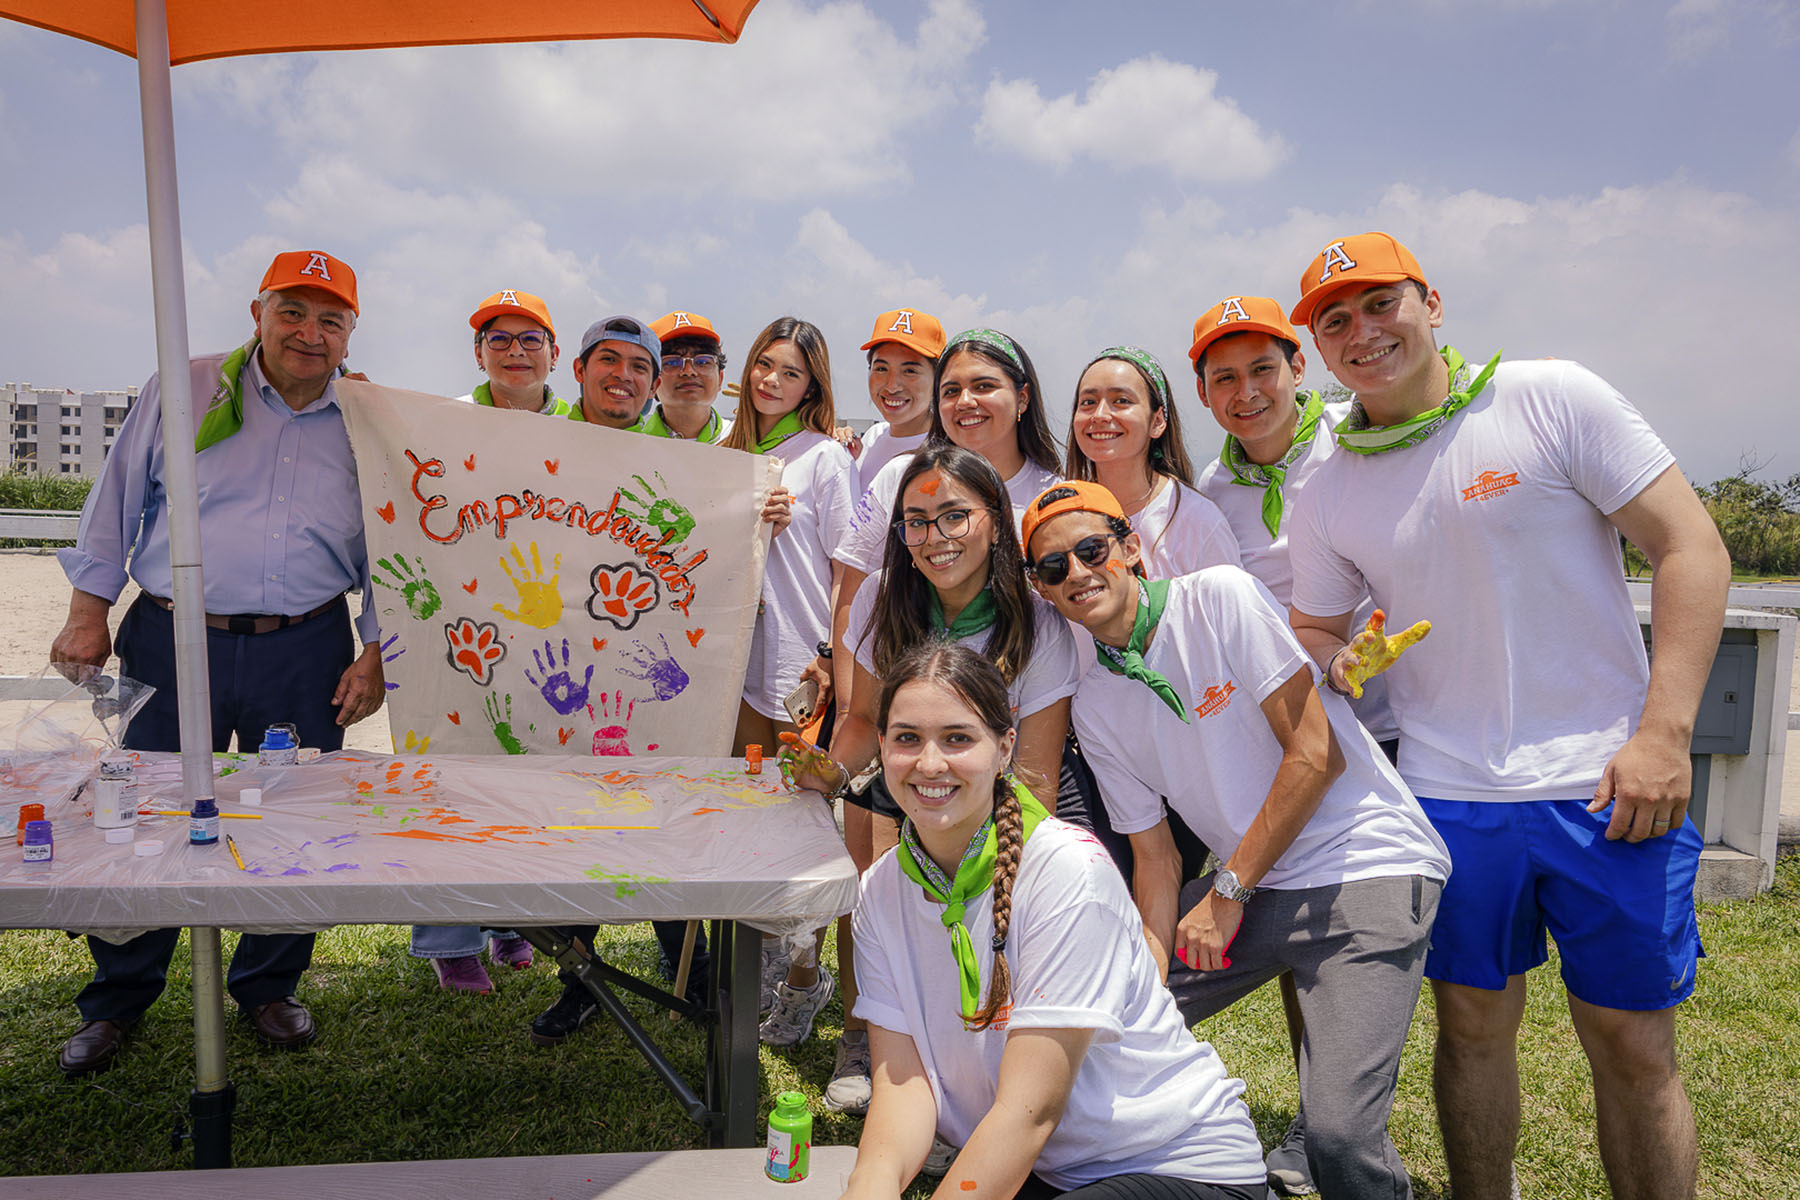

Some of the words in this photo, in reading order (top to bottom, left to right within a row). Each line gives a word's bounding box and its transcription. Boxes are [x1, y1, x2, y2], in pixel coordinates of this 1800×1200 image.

[300, 252, 331, 281] A
[1319, 241, 1357, 285] A
[499, 290, 521, 307] A
[673, 312, 693, 330] A
[887, 310, 914, 335] A
[1216, 297, 1251, 326] A
[1467, 476, 1514, 499] ANAHUAC
[1479, 489, 1507, 502] 4EVER
